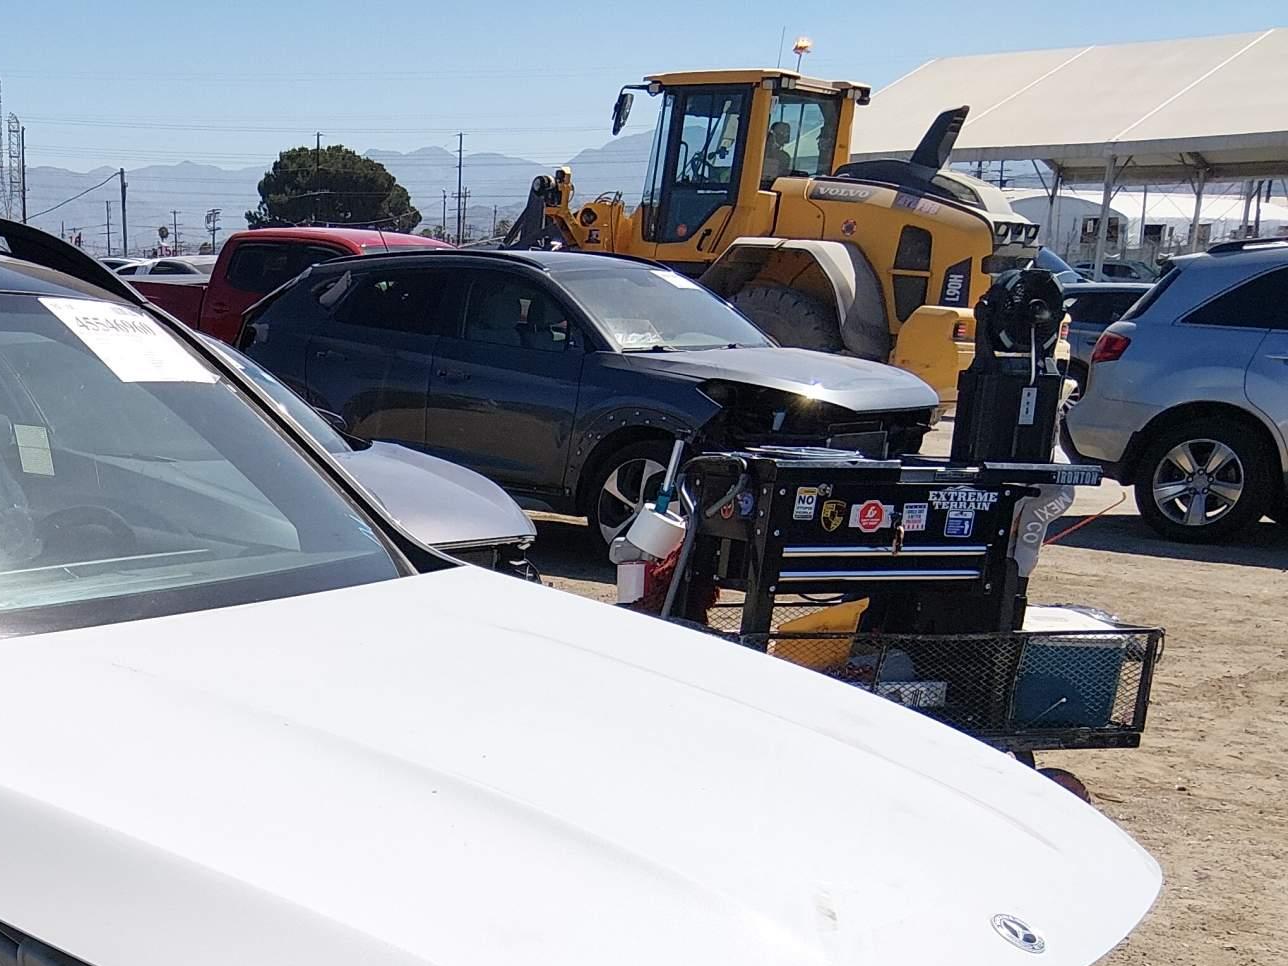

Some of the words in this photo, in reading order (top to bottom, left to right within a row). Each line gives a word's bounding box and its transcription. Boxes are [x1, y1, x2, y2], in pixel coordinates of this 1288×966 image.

[818, 187, 871, 198] VOLVO
[945, 274, 964, 302] L90H
[1056, 470, 1098, 485] IRONTON
[798, 495, 814, 505] NO
[928, 490, 999, 503] EXTREME
[932, 501, 991, 511] TERRAIN
